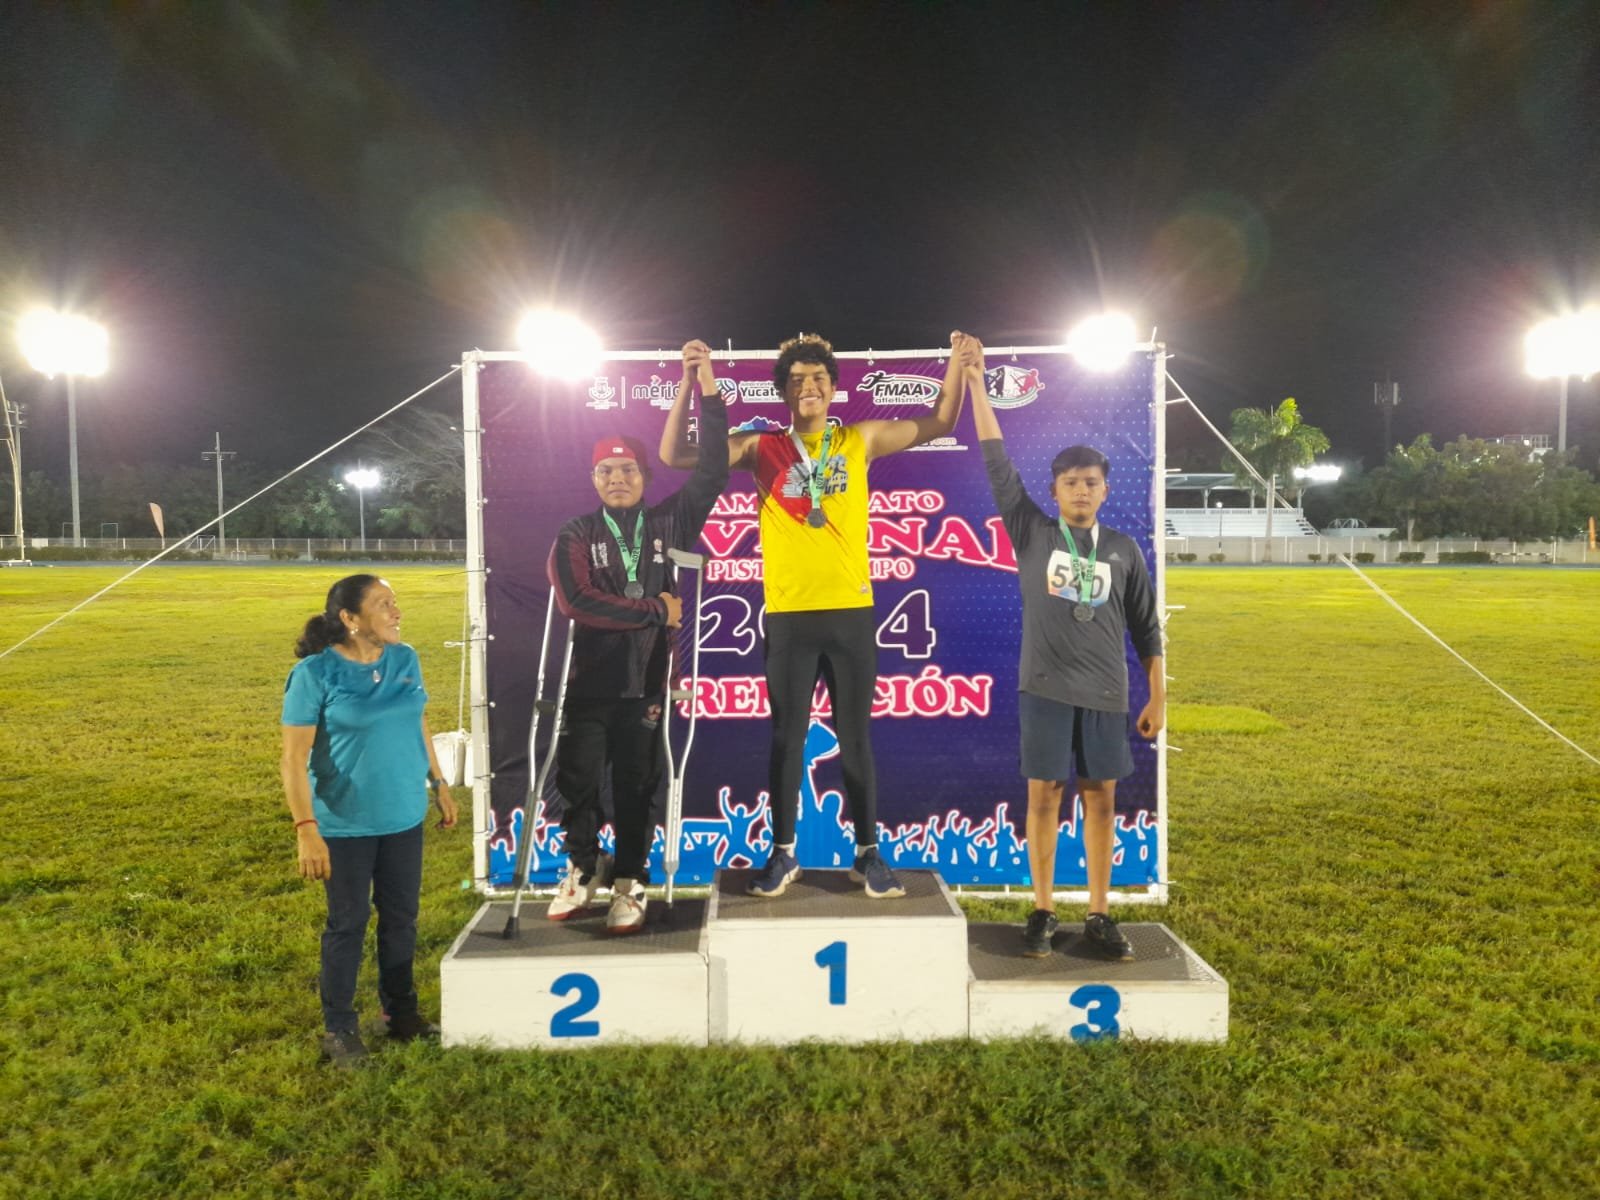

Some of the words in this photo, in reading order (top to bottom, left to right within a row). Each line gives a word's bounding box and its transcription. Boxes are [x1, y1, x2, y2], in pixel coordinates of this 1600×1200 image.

[740, 386, 779, 397] Yucat
[875, 383, 923, 396] FMAA
[815, 941, 847, 1005] 1
[550, 973, 600, 1037] 2
[1070, 984, 1121, 1042] 3
